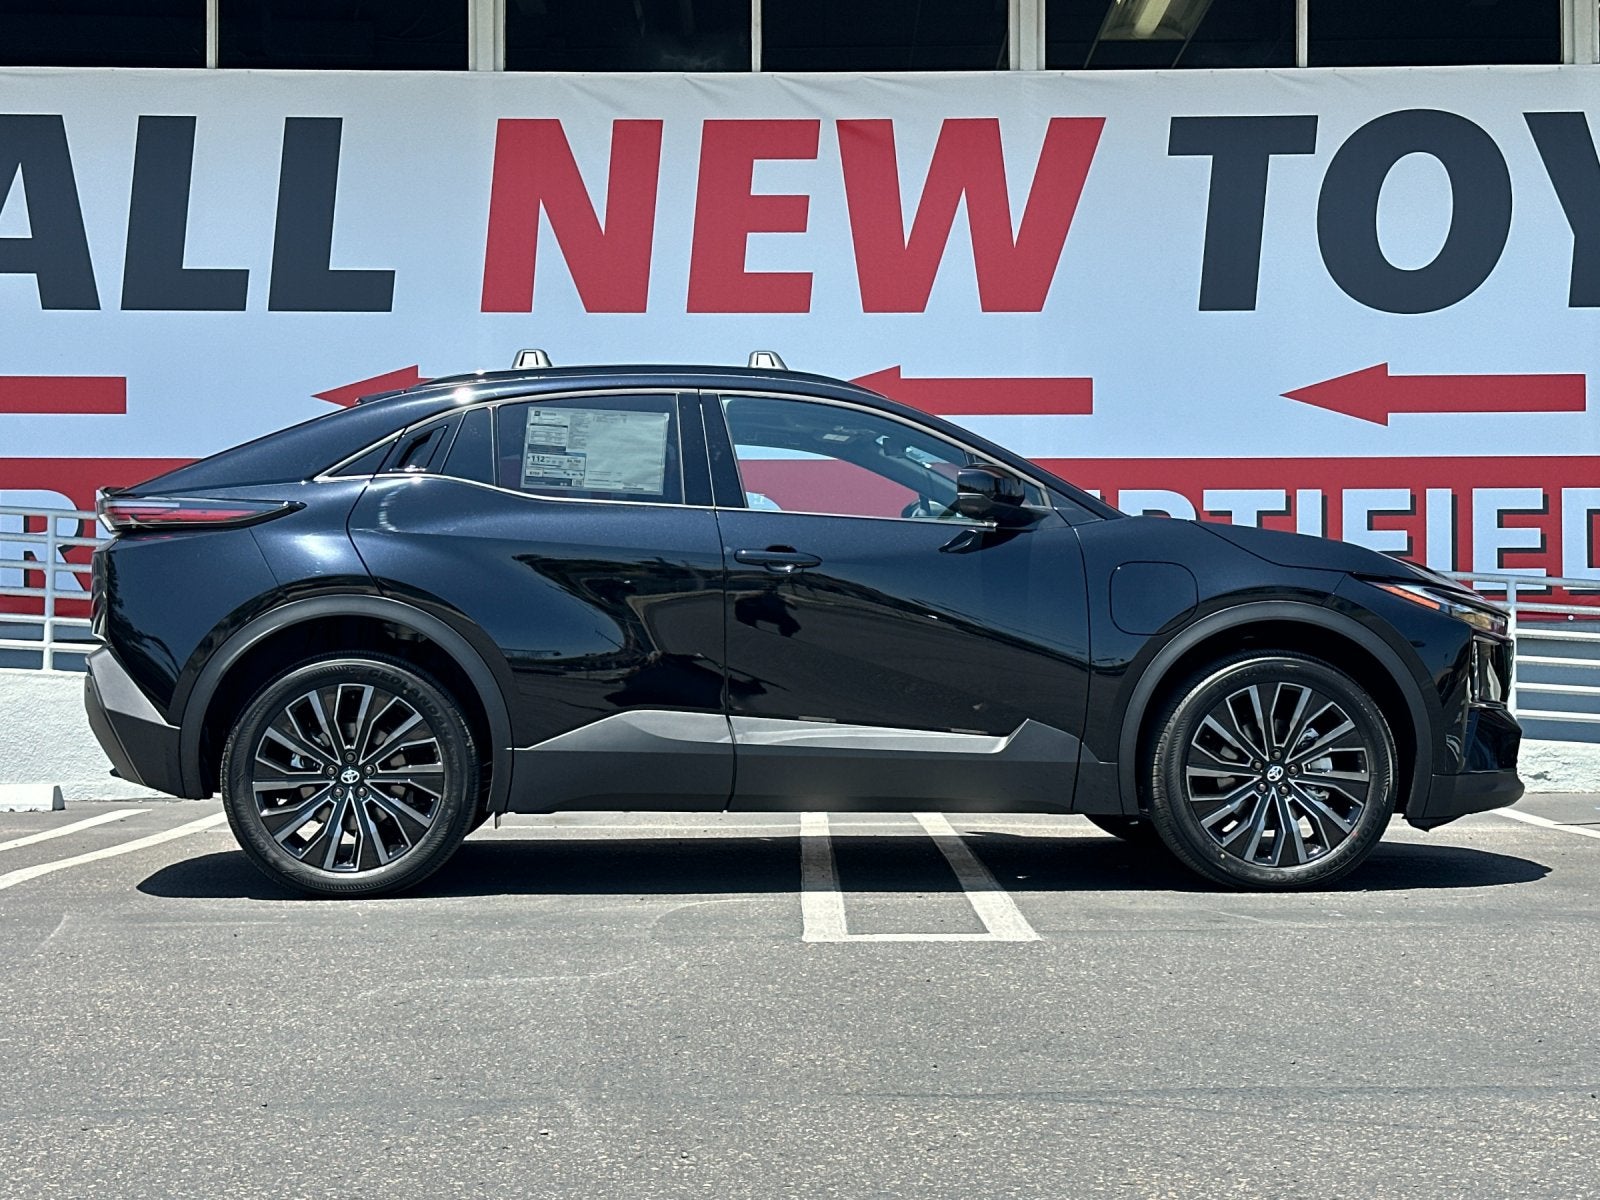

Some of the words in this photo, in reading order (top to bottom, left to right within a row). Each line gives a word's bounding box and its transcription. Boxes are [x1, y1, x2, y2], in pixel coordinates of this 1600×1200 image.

[0, 114, 395, 312] ALL
[481, 117, 1106, 313] NEW
[1084, 487, 1600, 592] TIFIE
